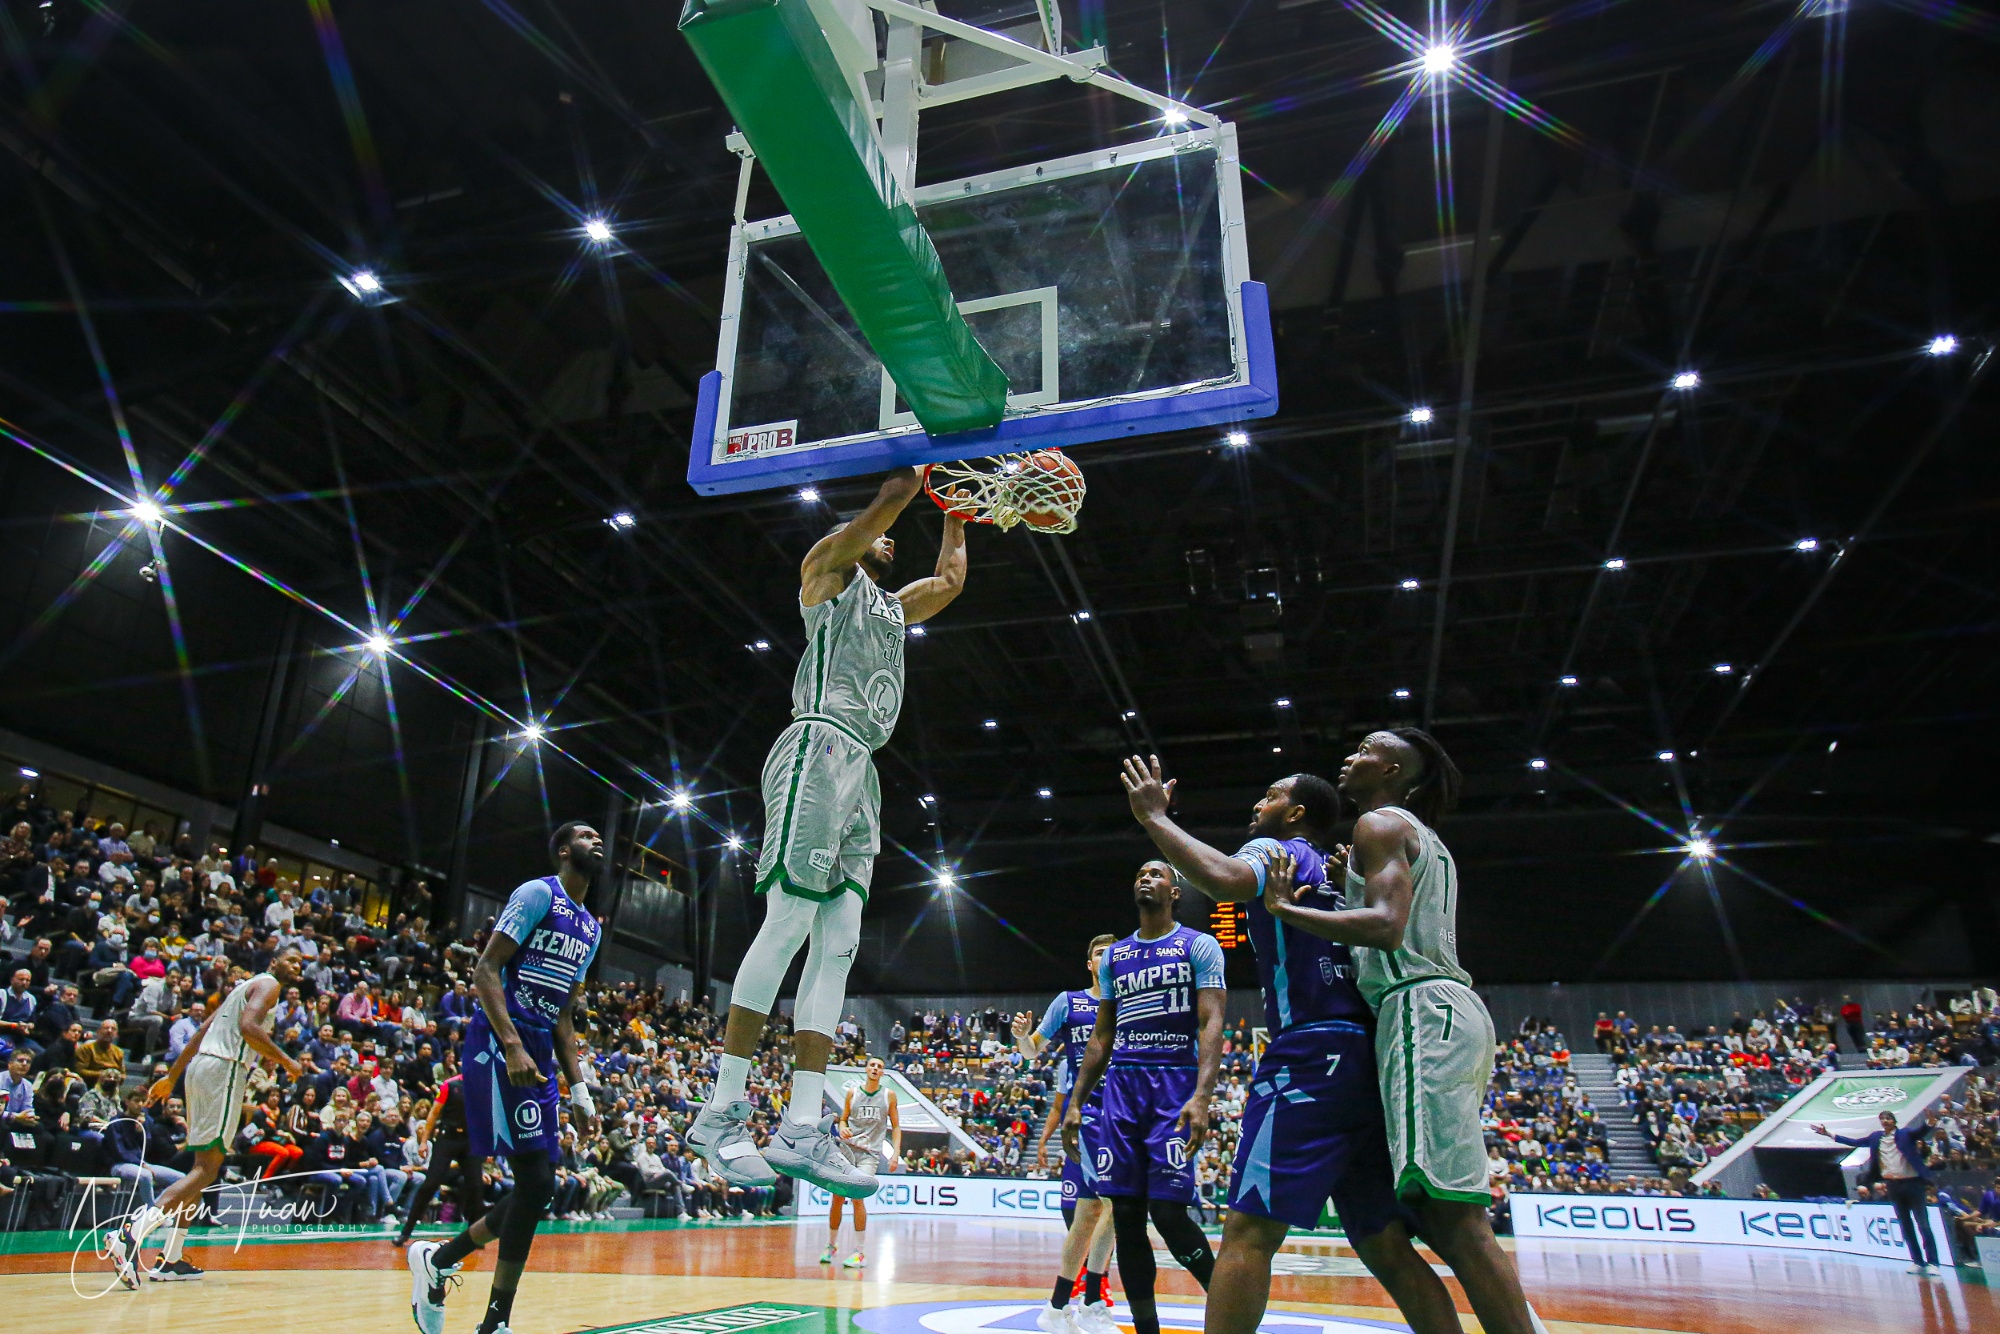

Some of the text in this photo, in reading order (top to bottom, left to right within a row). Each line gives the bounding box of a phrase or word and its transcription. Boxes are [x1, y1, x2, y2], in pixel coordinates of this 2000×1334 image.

[552, 904, 575, 920] SOFT
[1112, 949, 1142, 962] SOFT
[1167, 986, 1191, 1014] 11
[1072, 1004, 1100, 1013] SOFT
[1434, 1003, 1454, 1043] 7
[1070, 1024, 1096, 1043] KE
[1128, 1030, 1189, 1042] écomiam
[1326, 1054, 1341, 1076] 7
[856, 1105, 881, 1120] ADA
